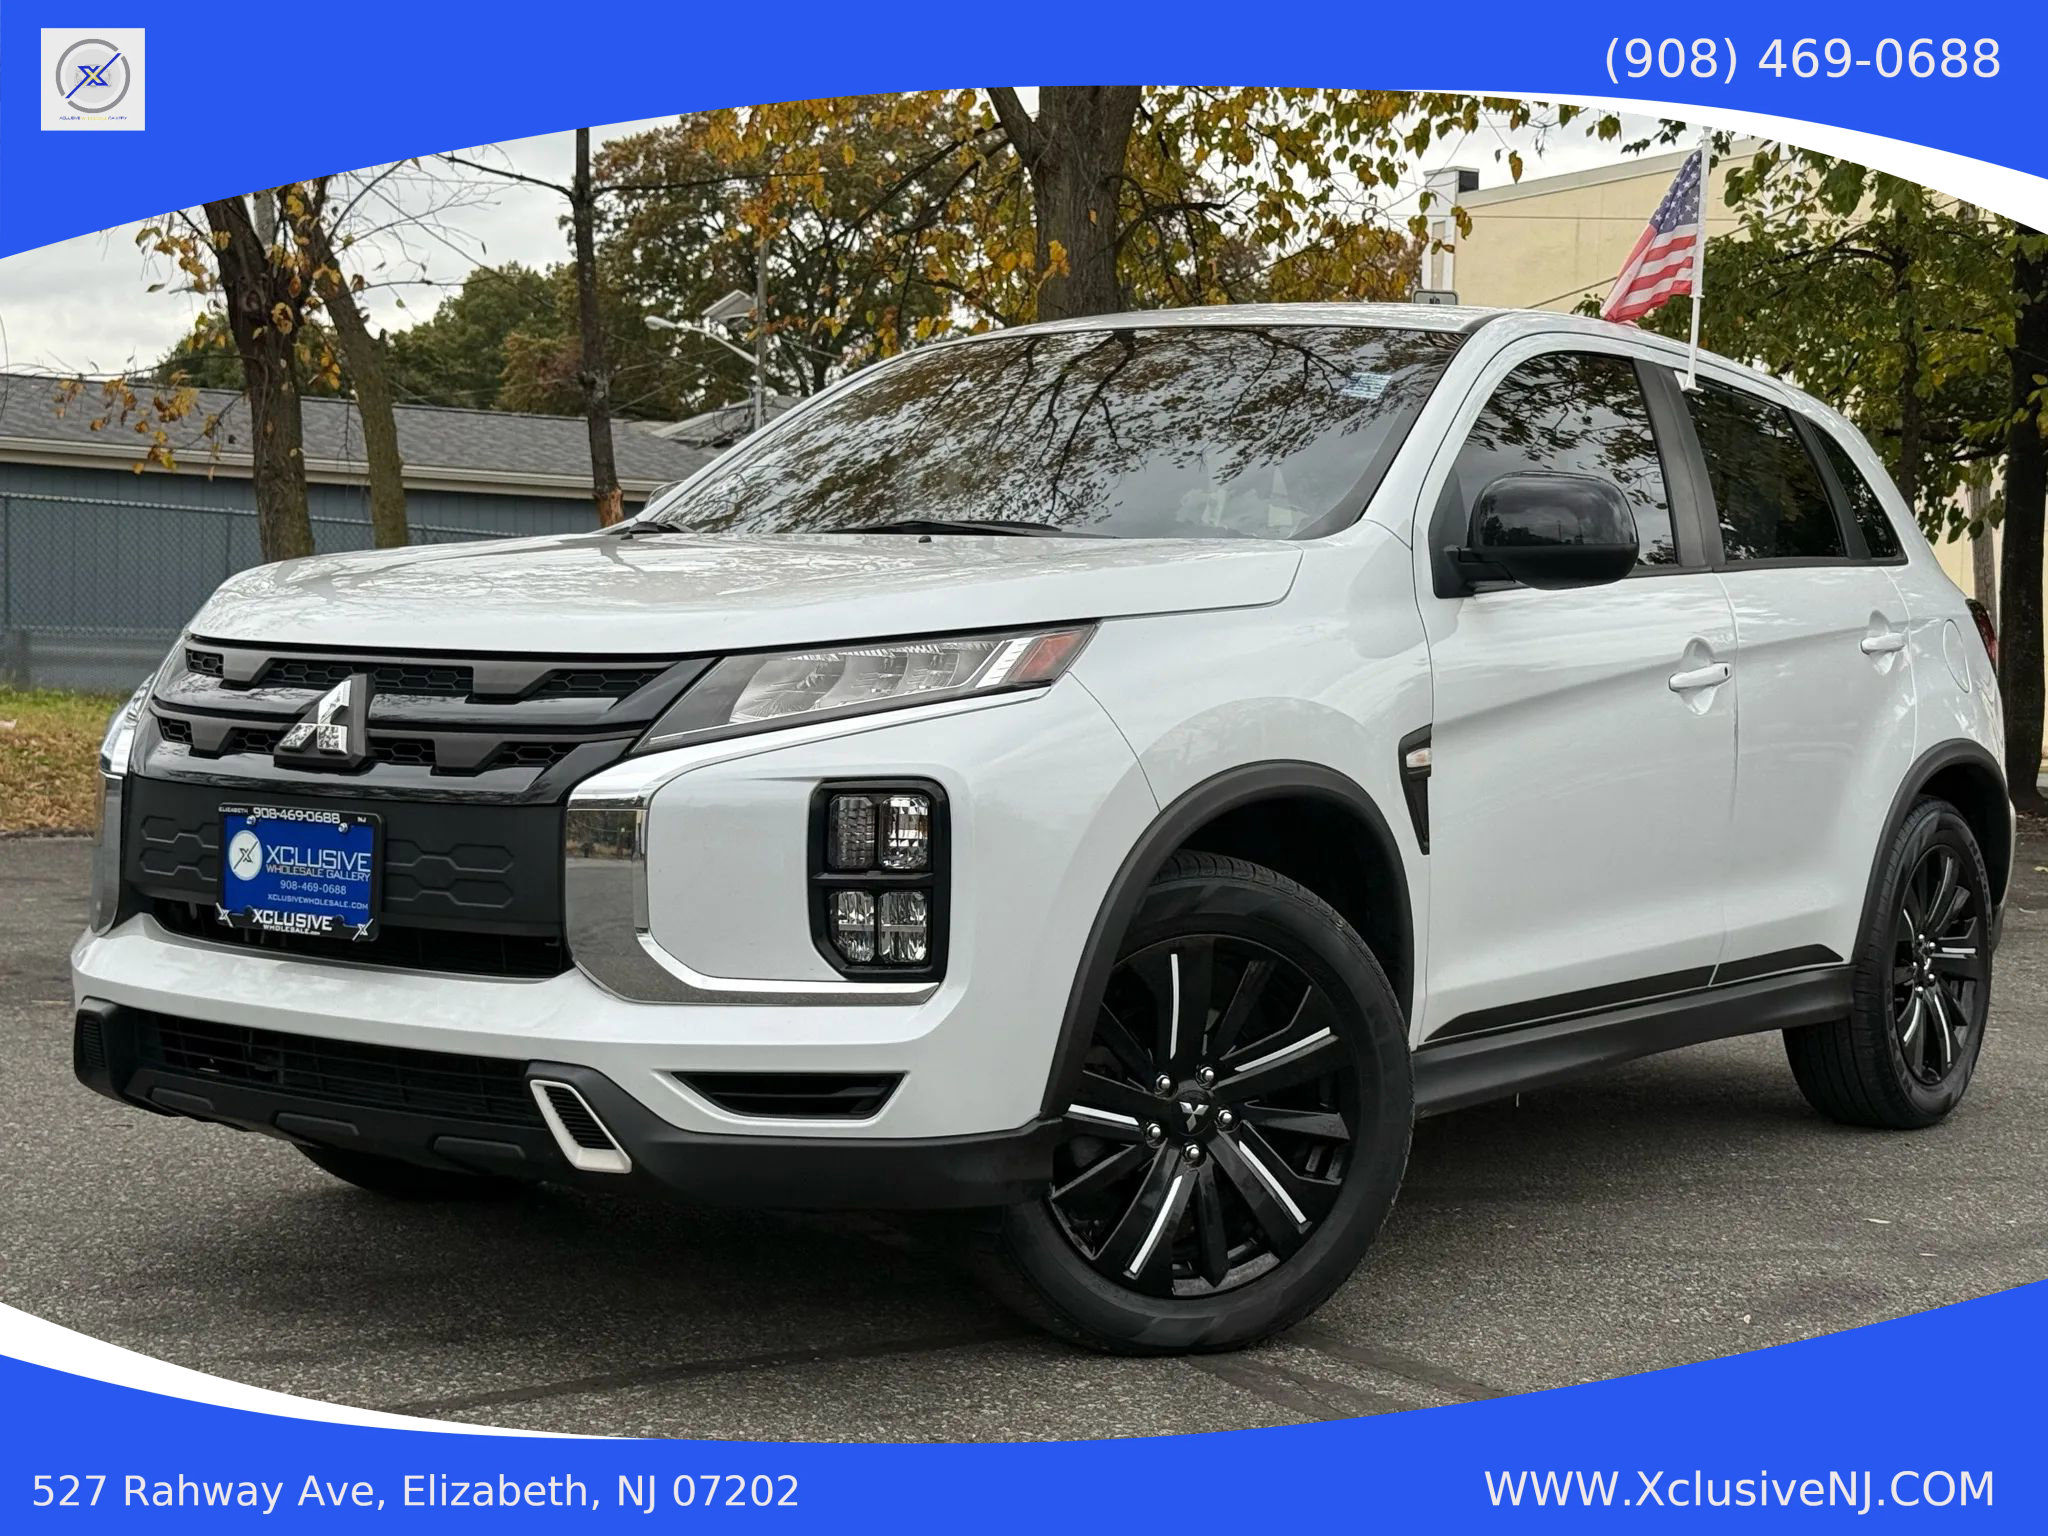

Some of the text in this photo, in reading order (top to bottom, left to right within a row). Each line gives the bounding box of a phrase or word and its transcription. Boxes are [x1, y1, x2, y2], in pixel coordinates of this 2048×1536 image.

[253, 806, 341, 825] 908-469-0688
[266, 844, 372, 873] XCLUSIVE
[266, 863, 371, 882] WHOLESALE GALLERY
[280, 879, 347, 895] 908-469-0688
[267, 893, 369, 910] XCLUSIVEWHOLESALE.COM
[252, 908, 333, 931] XCLUSIVE
